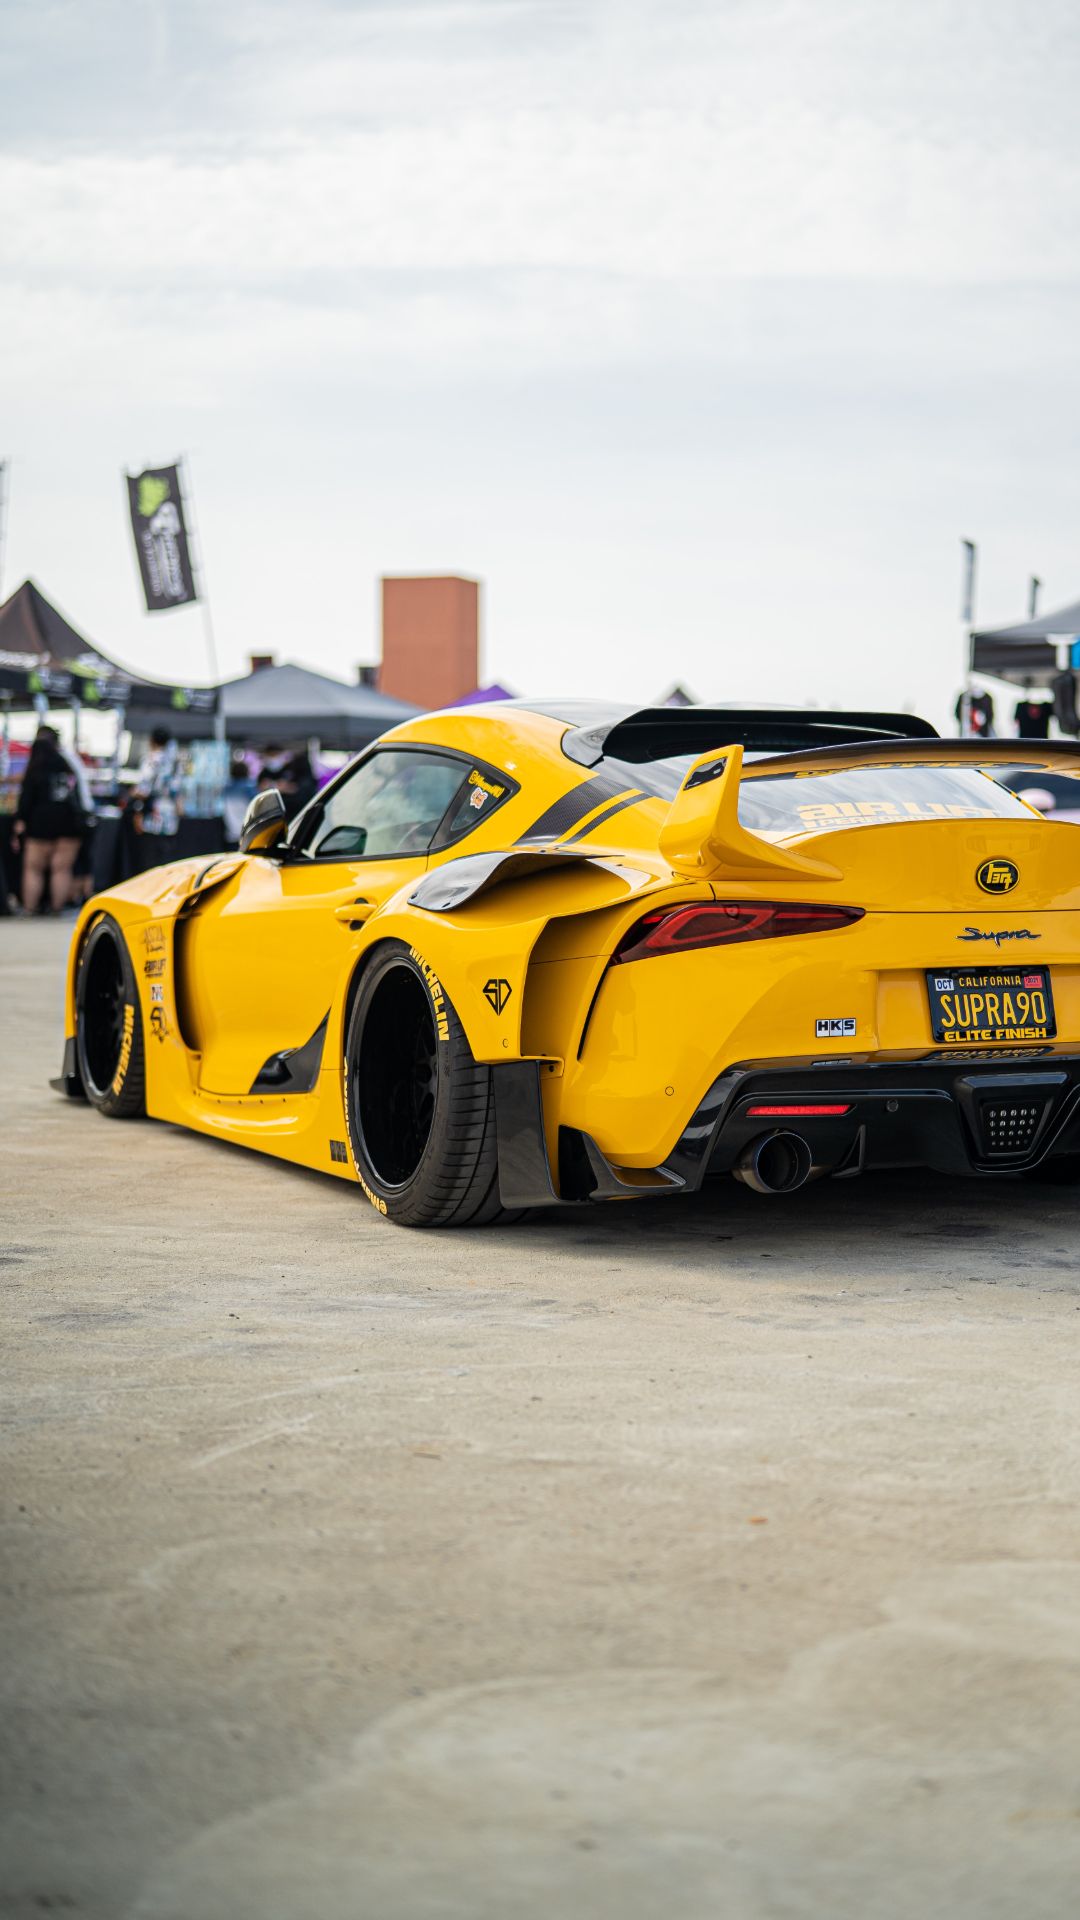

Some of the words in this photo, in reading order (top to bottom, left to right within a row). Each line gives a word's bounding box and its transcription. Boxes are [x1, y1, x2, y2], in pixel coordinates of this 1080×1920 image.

[957, 927, 1042, 948] Supra
[937, 980, 953, 991] OCT
[958, 975, 1022, 988] CALIFORNIA
[940, 991, 1047, 1028] SUPRA90
[817, 1019, 855, 1031] HKS
[943, 1030, 992, 1042] ELITE
[996, 1028, 1047, 1040] FINISH
[112, 1004, 135, 1096] MICHELIN
